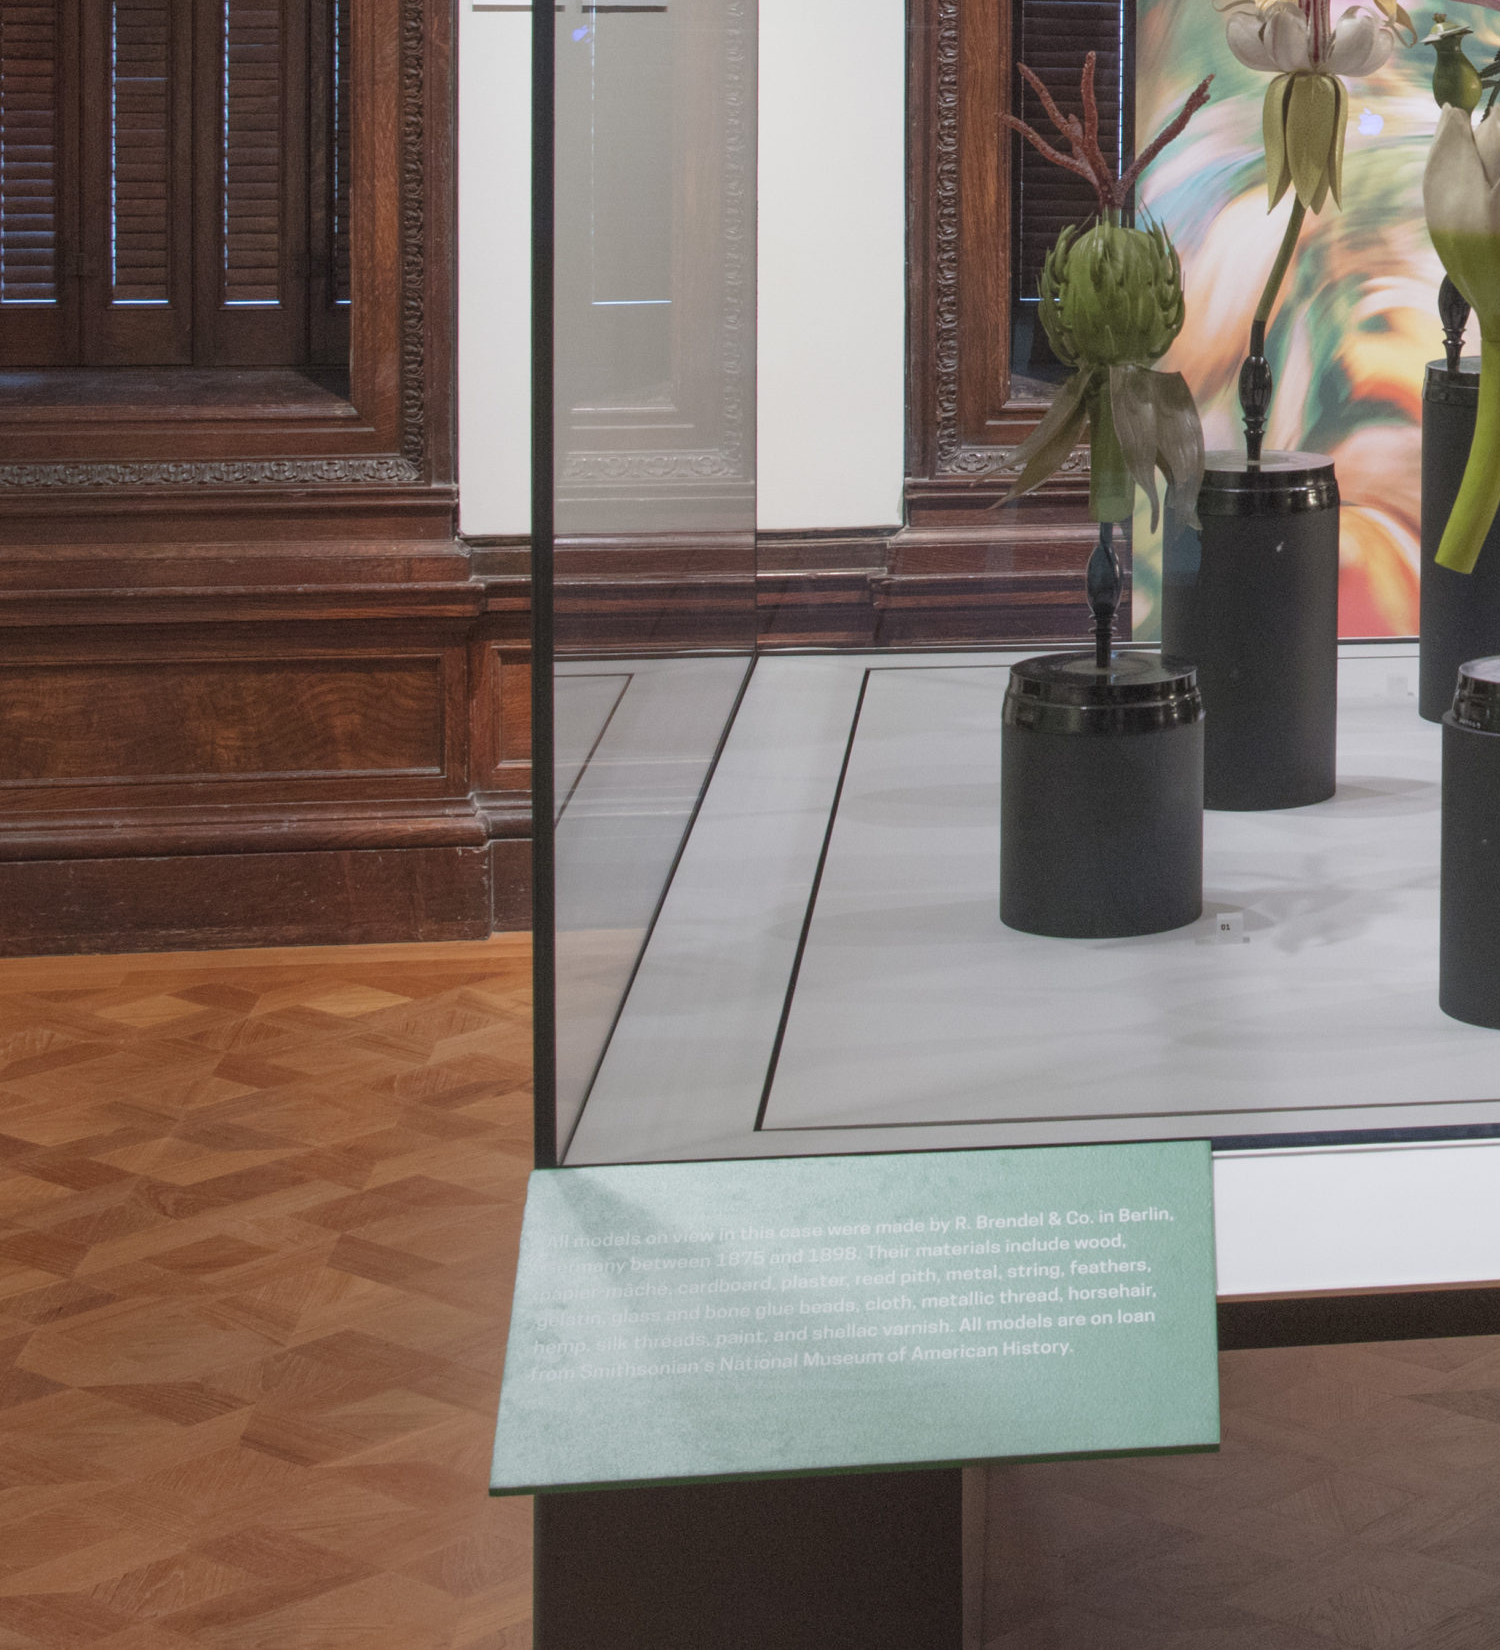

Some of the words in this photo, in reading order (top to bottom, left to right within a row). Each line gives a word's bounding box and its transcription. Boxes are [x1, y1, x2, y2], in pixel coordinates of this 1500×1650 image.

[778, 1226, 825, 1239] case
[827, 1219, 872, 1236] were
[875, 1217, 926, 1235] made
[928, 1215, 952, 1235] by
[954, 1215, 972, 1231] R.
[975, 1211, 1044, 1230] Brendel
[1048, 1211, 1062, 1227] &
[1065, 1210, 1094, 1225] Co.
[1098, 1209, 1115, 1224] in
[1118, 1205, 1174, 1223] Berlin,
[769, 1248, 805, 1268] and
[807, 1246, 861, 1264] 1898.
[866, 1244, 912, 1260] Their
[915, 1239, 1001, 1258] materials
[1005, 1236, 1070, 1253] include
[1073, 1232, 1127, 1250] wood,
[780, 1273, 850, 1292] plaster,
[855, 1266, 896, 1286] reed
[900, 1267, 941, 1287] pith,
[945, 1264, 1003, 1282] metal,
[1006, 1262, 1065, 1280] string,
[1069, 1258, 1152, 1276] feathers,
[754, 1300, 795, 1321] glue
[799, 1297, 860, 1315] beads,
[865, 1294, 917, 1312] cloth,
[921, 1290, 995, 1309] metallic
[999, 1286, 1064, 1305] thread,
[1067, 1282, 1157, 1301] horsehair,
[812, 1322, 879, 1340] shellac
[882, 1318, 955, 1337] varnish.
[958, 1316, 982, 1333] All
[985, 1312, 1053, 1331] models
[1057, 1314, 1087, 1328] are
[1089, 1313, 1114, 1326] on
[1117, 1308, 1156, 1324] loan
[802, 1350, 885, 1366] Museum
[886, 1345, 907, 1364] of
[910, 1343, 999, 1361] American
[1002, 1340, 1074, 1357] History.
